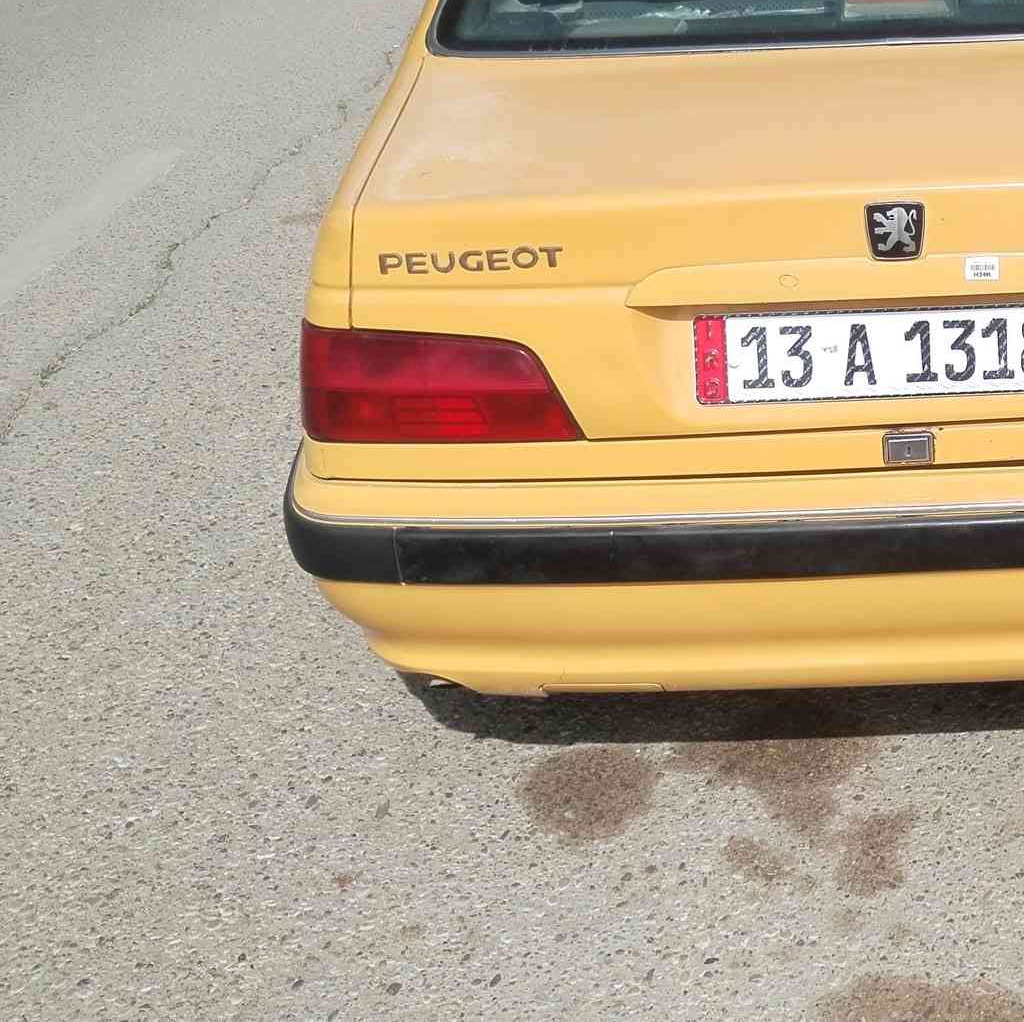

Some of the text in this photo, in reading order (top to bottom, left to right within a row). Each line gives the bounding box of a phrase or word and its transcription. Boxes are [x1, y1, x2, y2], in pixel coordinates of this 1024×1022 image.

[378, 246, 563, 275] PEUGEOT
[740, 325, 813, 389] 13
[844, 323, 877, 386] A
